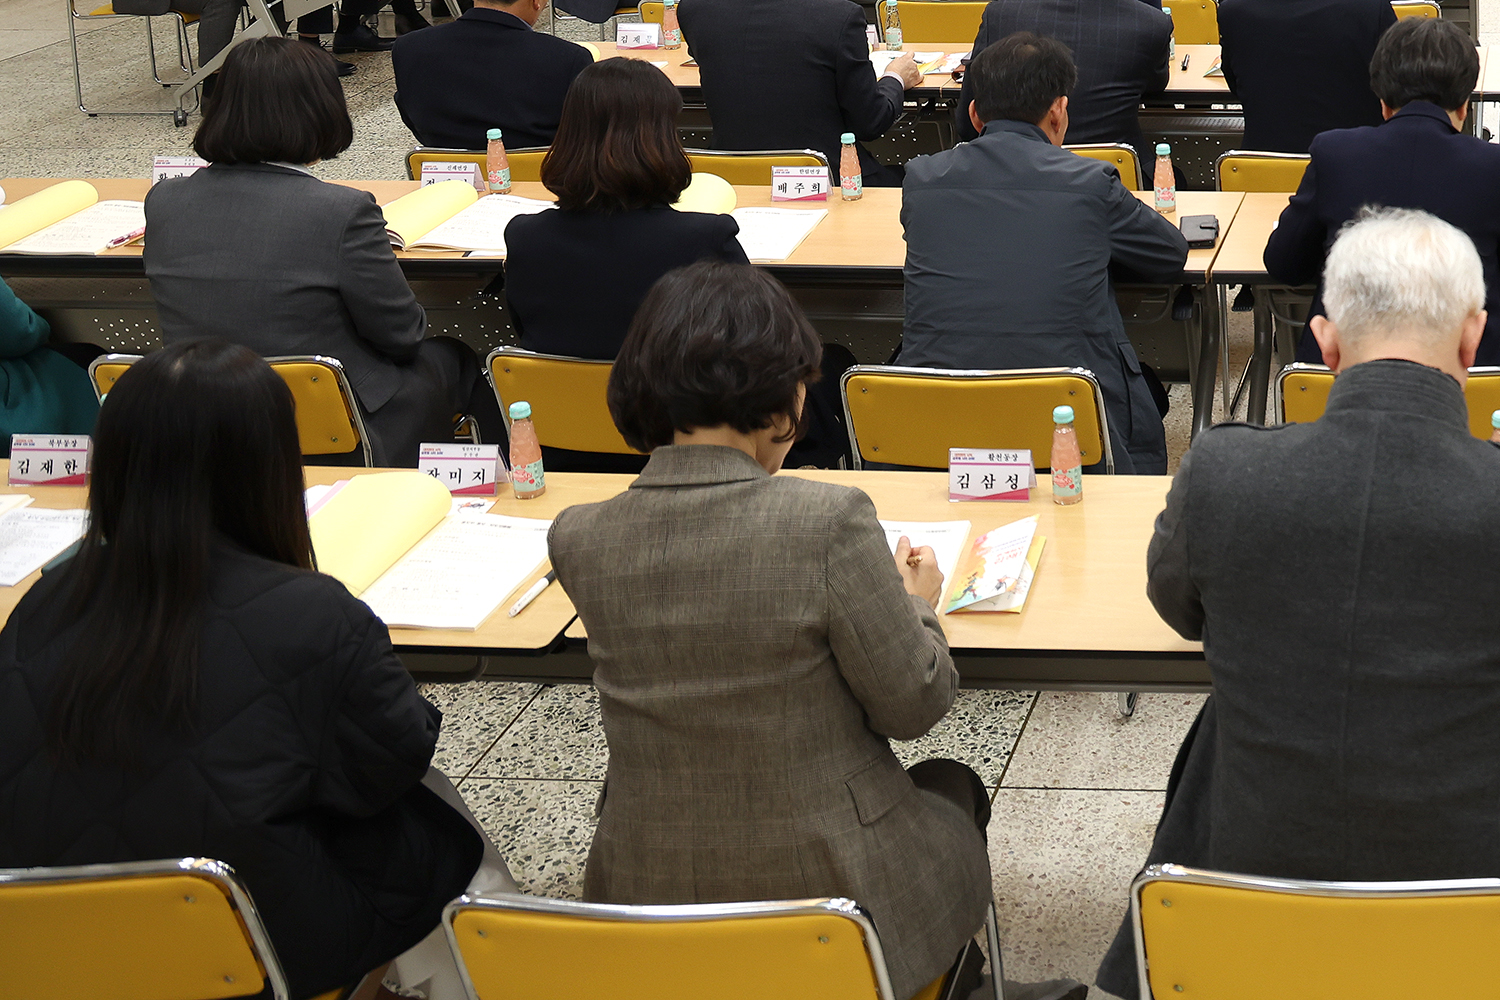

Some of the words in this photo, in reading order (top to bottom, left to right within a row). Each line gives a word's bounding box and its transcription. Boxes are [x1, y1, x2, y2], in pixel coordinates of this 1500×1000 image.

[777, 181, 821, 195] 배주희
[16, 458, 79, 476] 김재한
[956, 472, 1019, 491] 김삼성
